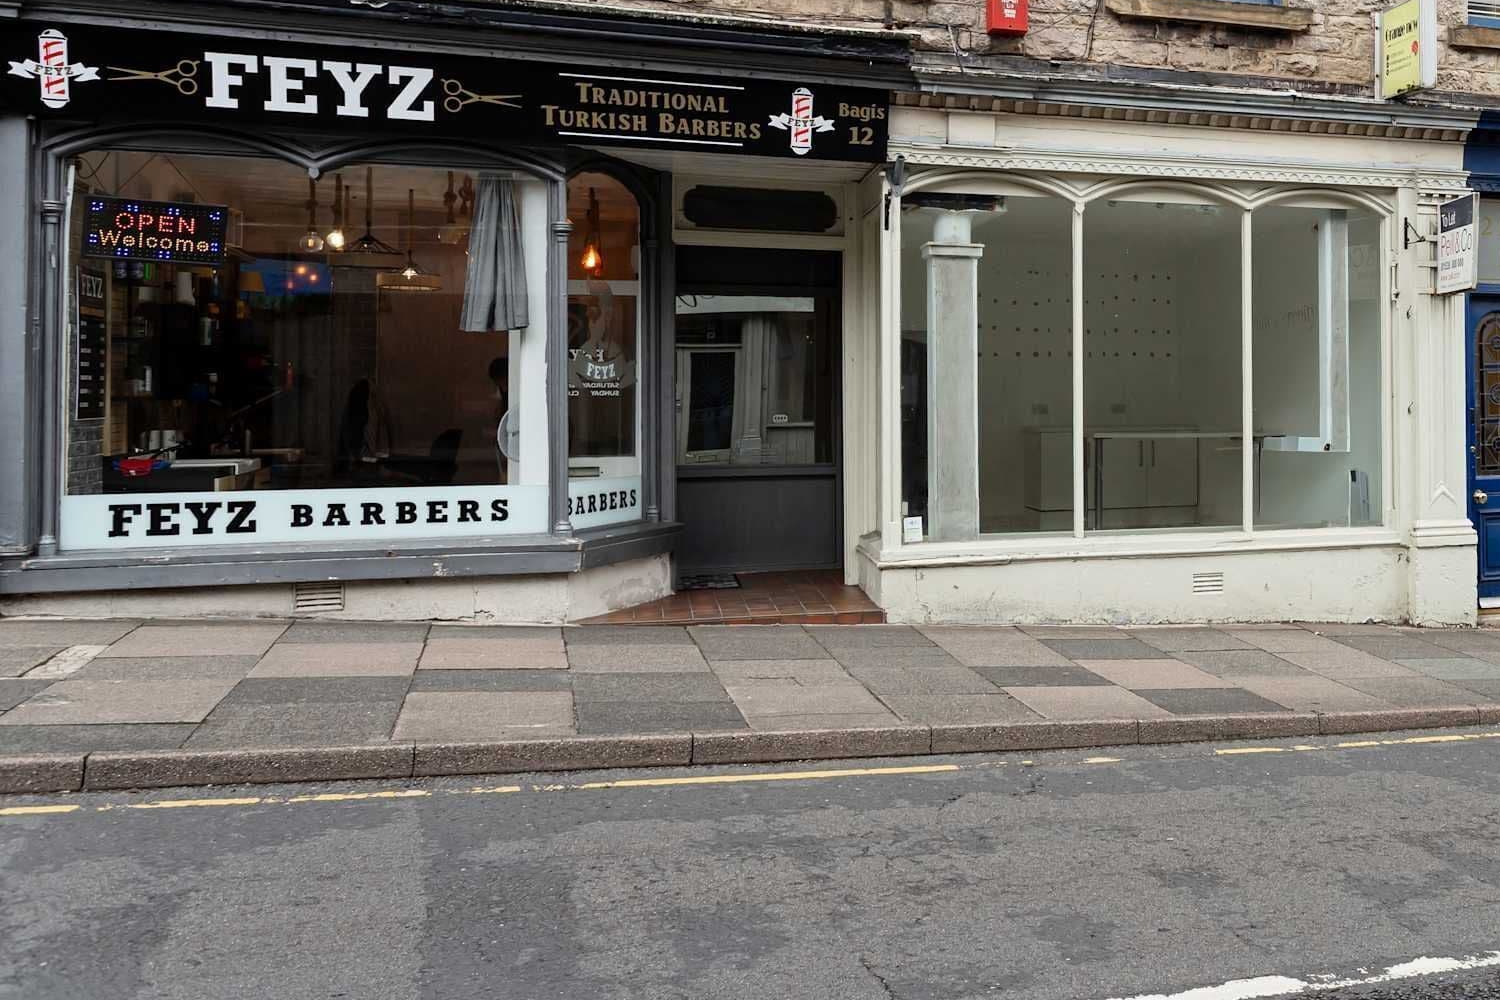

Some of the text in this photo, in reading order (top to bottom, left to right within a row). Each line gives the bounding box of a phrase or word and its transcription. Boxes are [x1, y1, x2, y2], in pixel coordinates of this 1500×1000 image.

[34, 64, 74, 76] FEYZ
[204, 51, 435, 121] FEYZ
[575, 82, 729, 114] TRADITIONAL
[540, 104, 761, 140] TURKISH BARBERS
[788, 117, 815, 128] FEYZ
[838, 102, 885, 122] Bagis
[848, 126, 874, 146] 12
[115, 212, 195, 234] OPEN
[1481, 217, 1492, 236] 2
[99, 229, 209, 252] Welcome
[81, 273, 103, 298] FEYZ
[586, 362, 616, 380] FEYZ
[108, 498, 509, 538] FEYZ BARBERS
